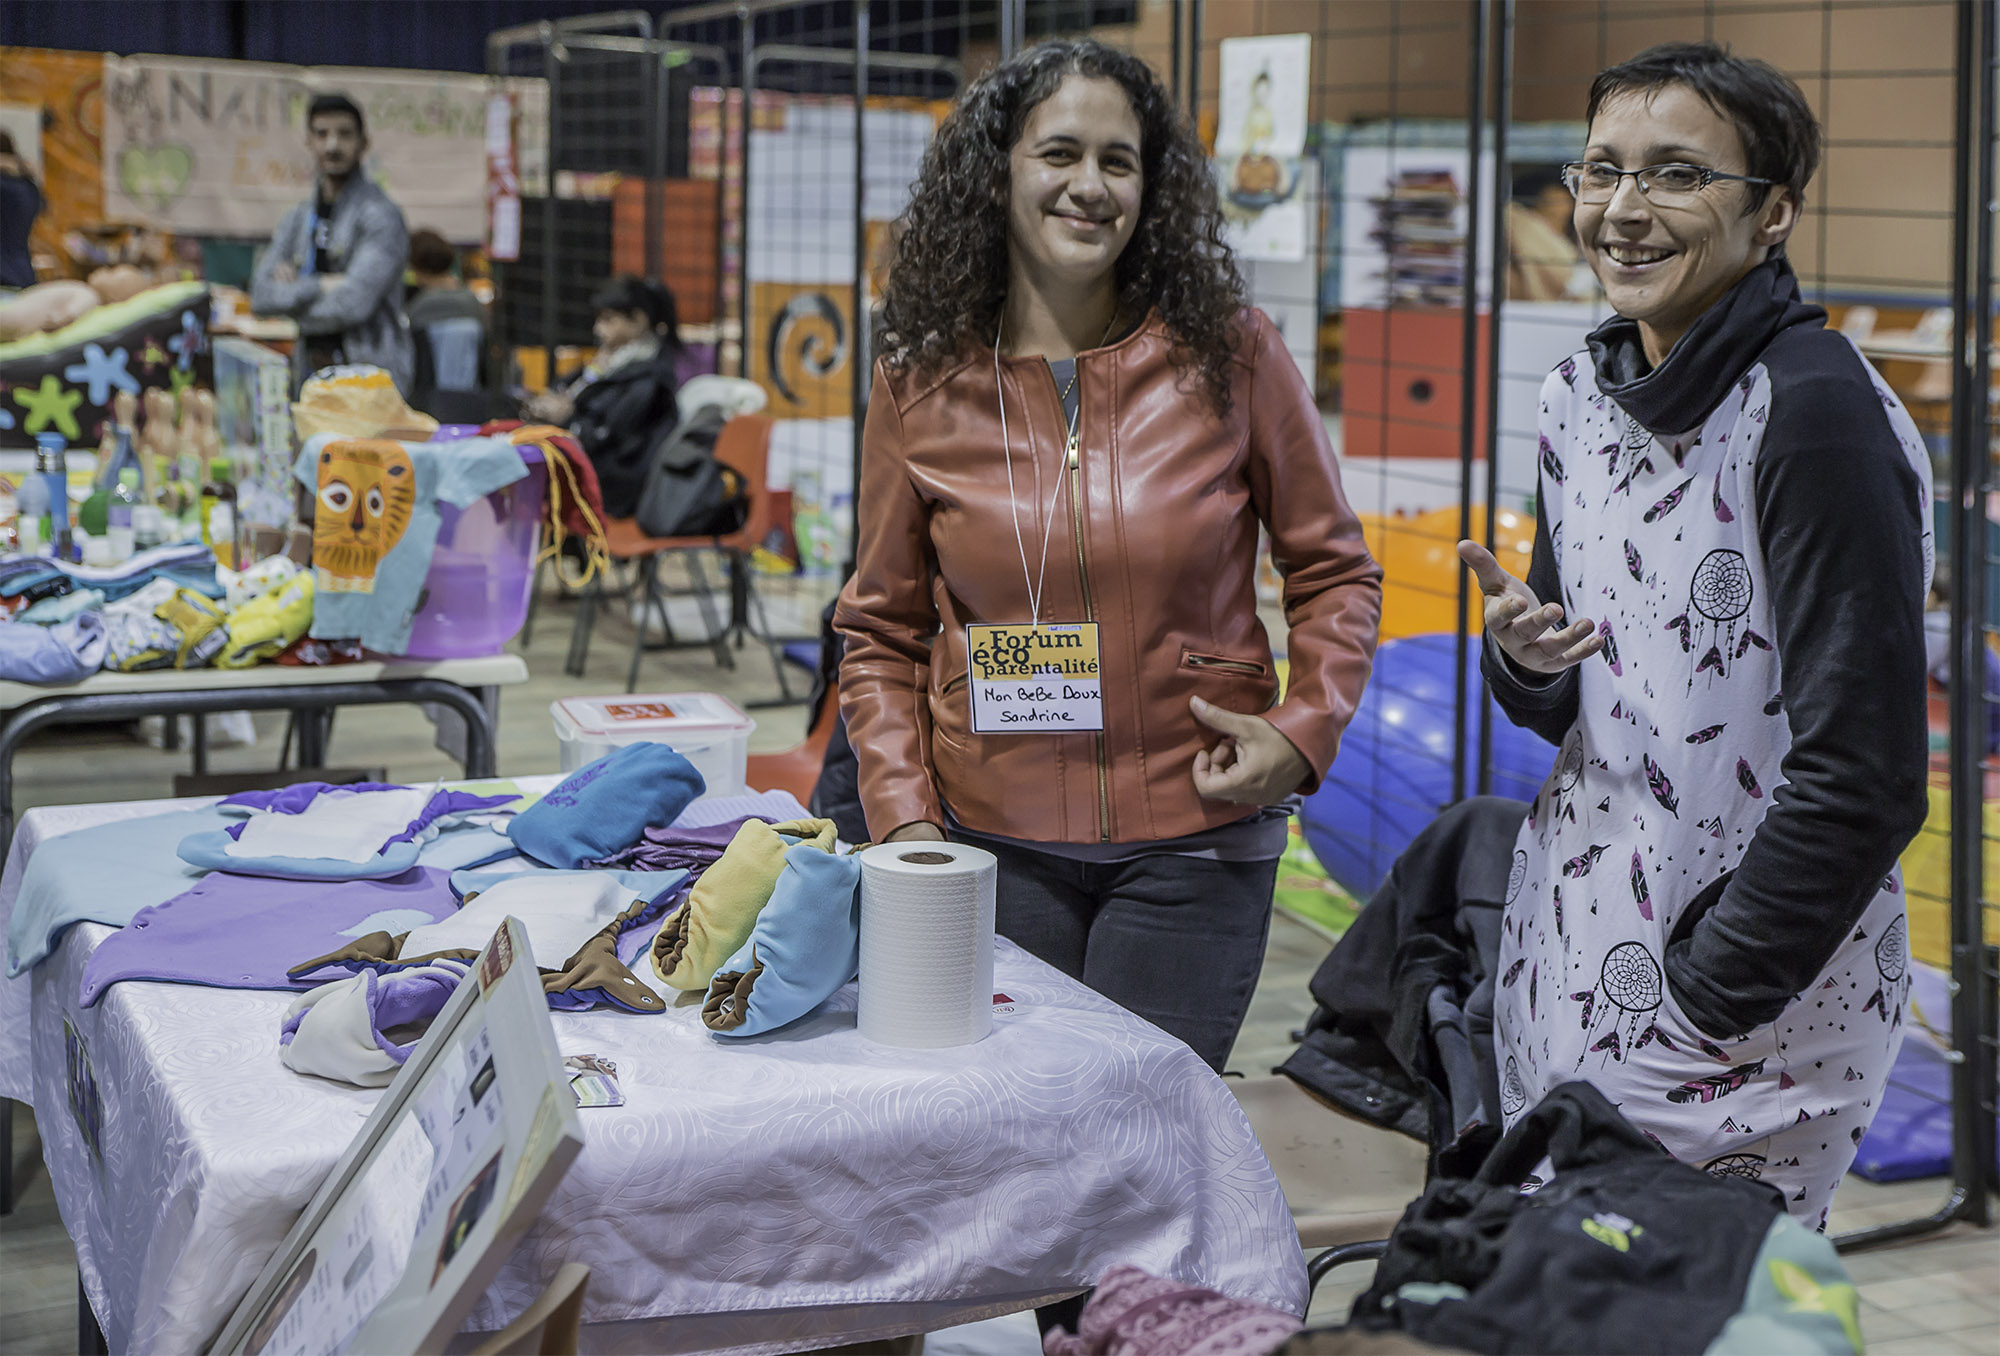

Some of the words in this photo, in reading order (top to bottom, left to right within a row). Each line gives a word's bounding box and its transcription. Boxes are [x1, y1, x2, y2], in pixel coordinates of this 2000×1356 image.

[990, 630, 1083, 650] Forum
[973, 642, 1030, 666] éco
[983, 658, 1098, 680] parentalité
[985, 687, 1012, 702] Mon
[1063, 685, 1101, 700] Doux
[1000, 708, 1075, 723] Sandrine
